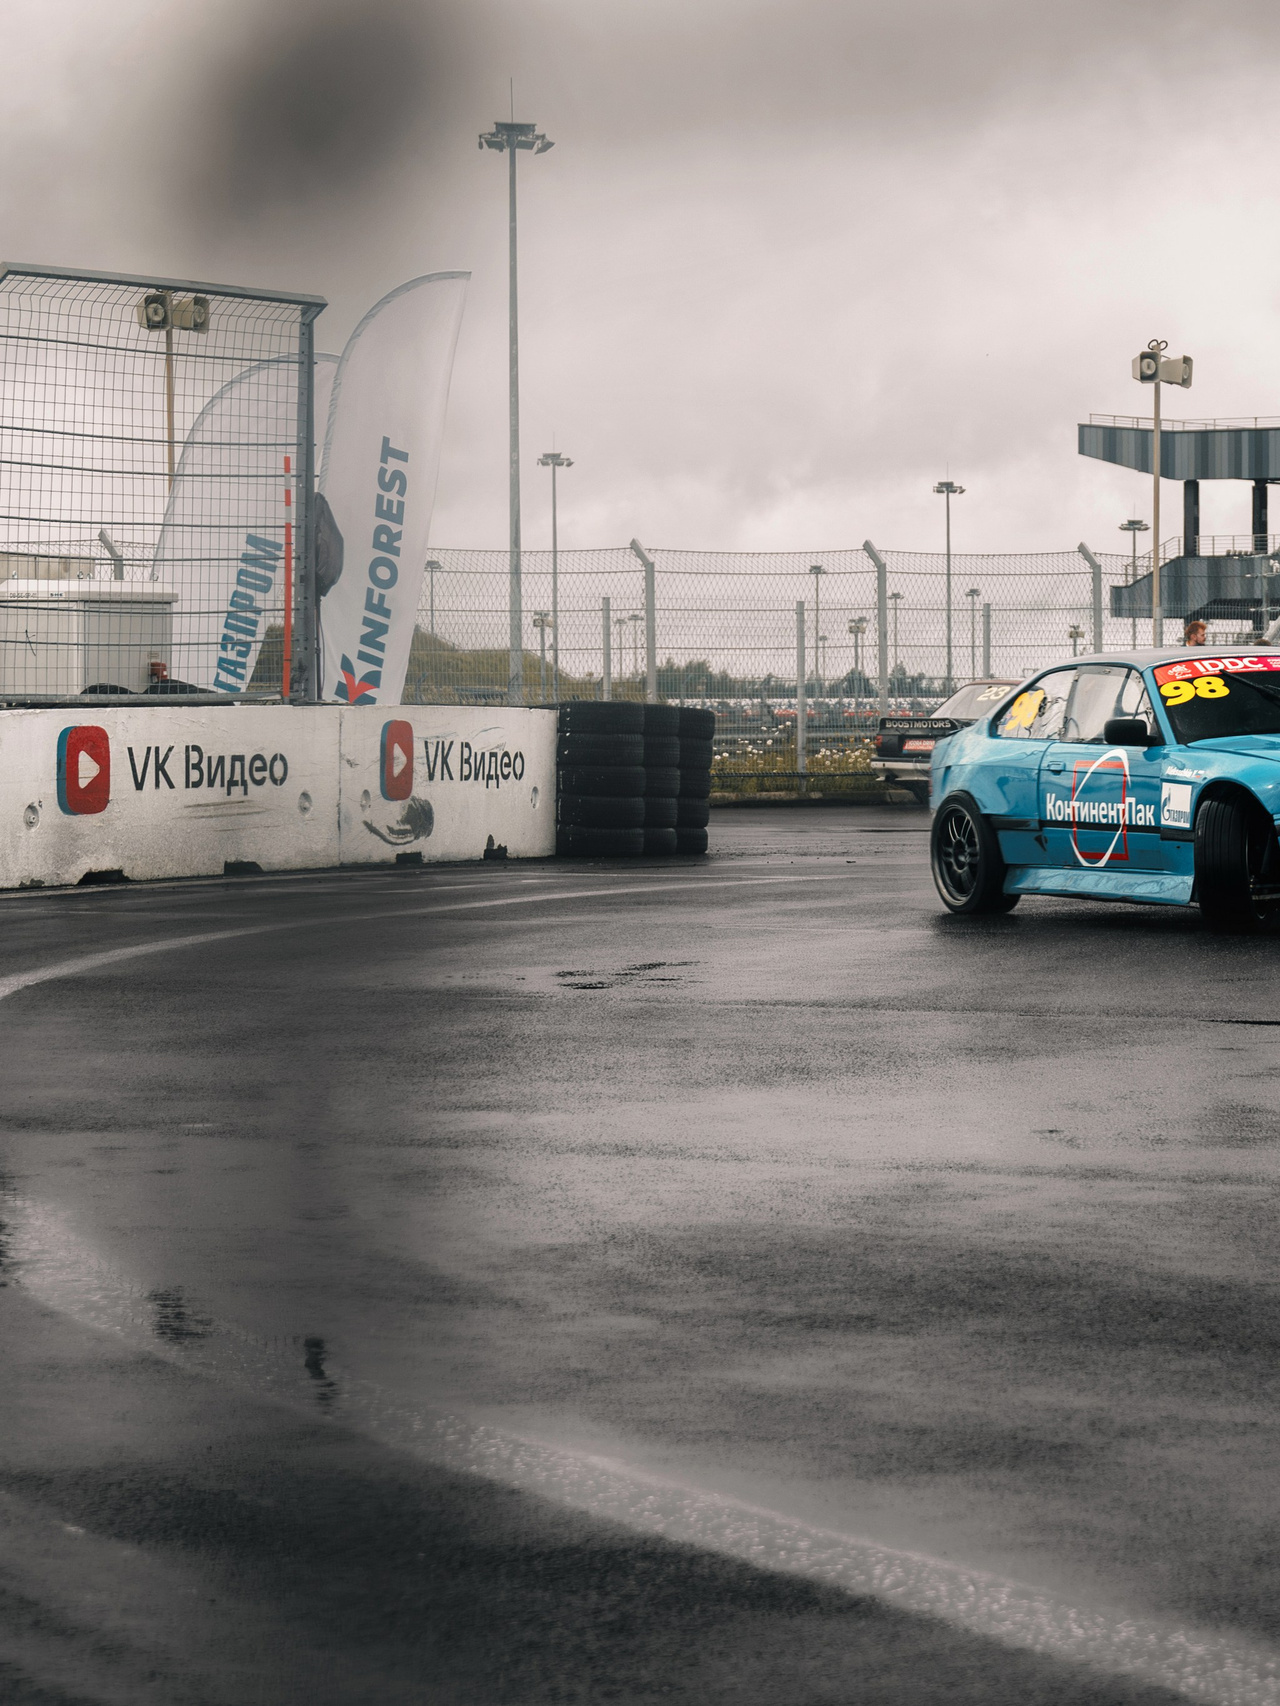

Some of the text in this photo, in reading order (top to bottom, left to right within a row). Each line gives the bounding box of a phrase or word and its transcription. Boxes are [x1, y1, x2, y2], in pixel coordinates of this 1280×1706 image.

[334, 435, 409, 705] KINFOREST
[213, 533, 284, 693] ГАЗПРОМ
[1193, 657, 1264, 673] IDDC
[977, 686, 1011, 701] 23
[1004, 689, 1045, 731] 98
[1159, 676, 1230, 707] 98
[885, 718, 952, 729] BOOSTMOTORS
[127, 744, 289, 796] VK Видео
[424, 740, 526, 788] VK Видео
[1046, 793, 1156, 826] КонтинентПак
